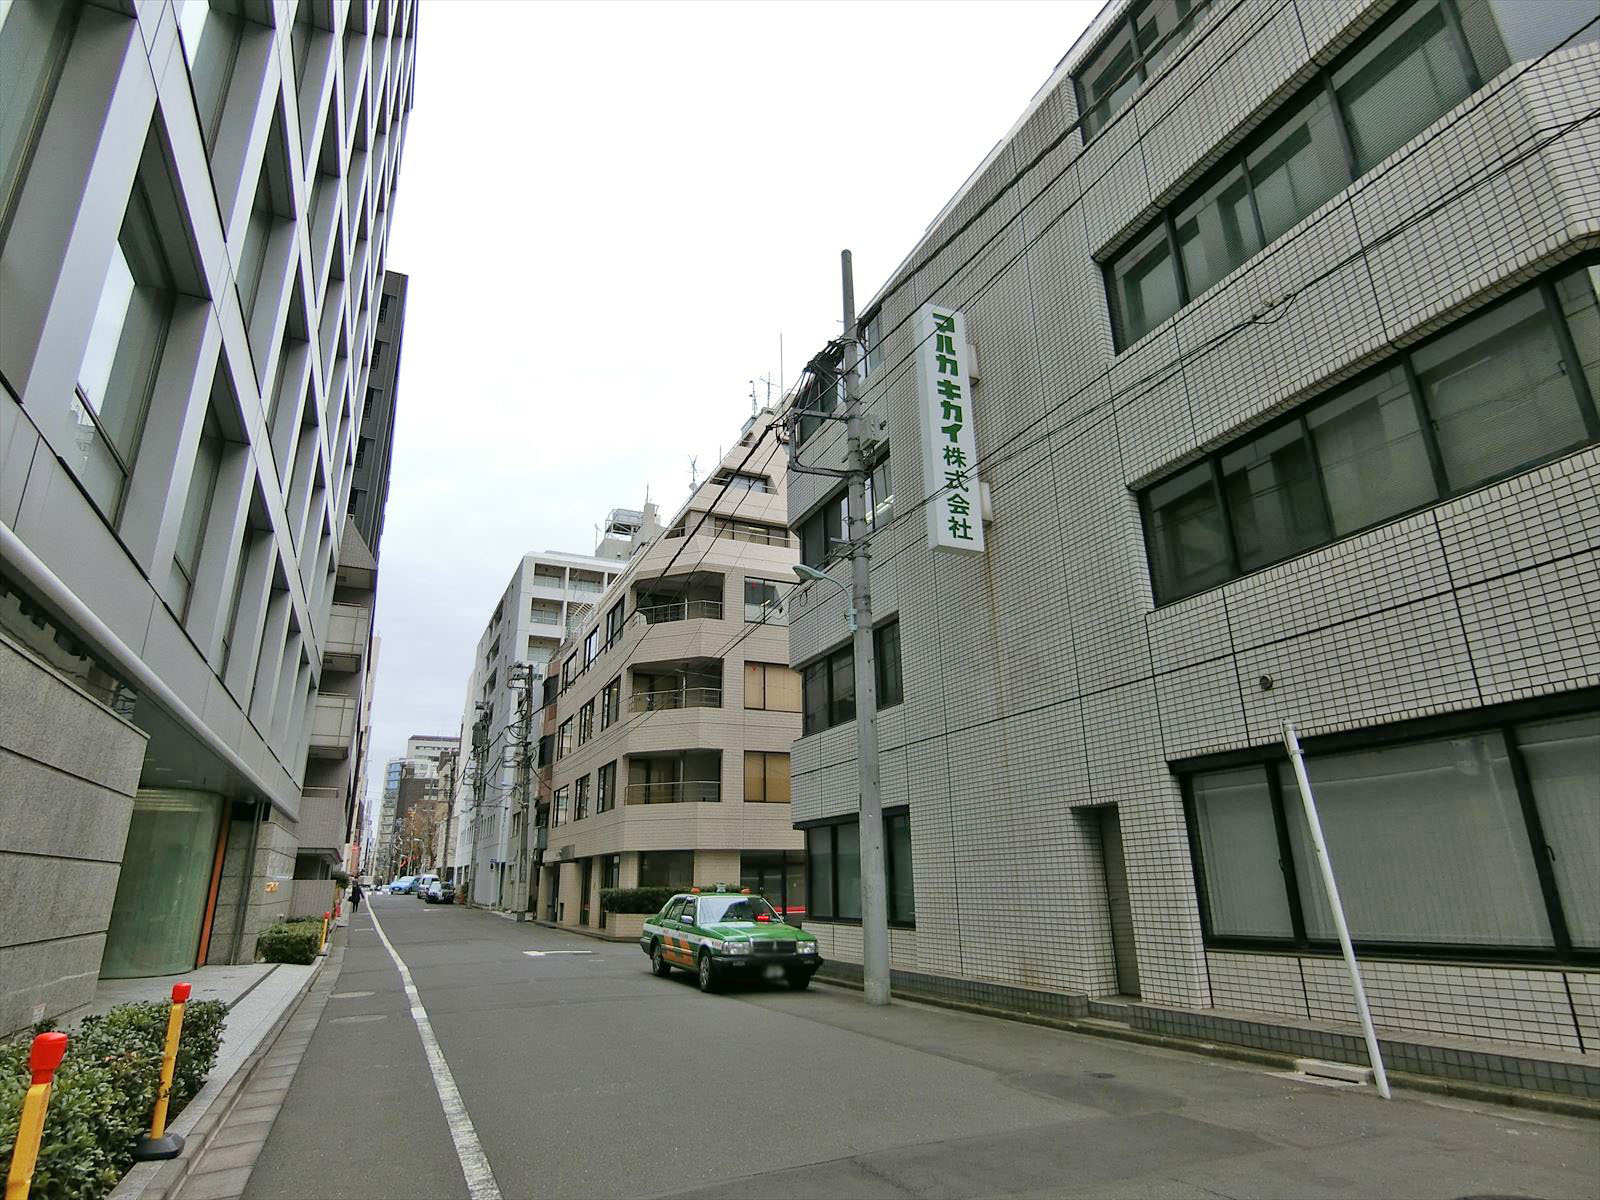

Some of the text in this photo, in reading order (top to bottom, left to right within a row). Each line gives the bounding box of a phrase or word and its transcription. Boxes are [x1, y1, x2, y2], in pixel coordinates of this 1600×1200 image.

[932, 312, 974, 540] マルカキカイ株式会社
